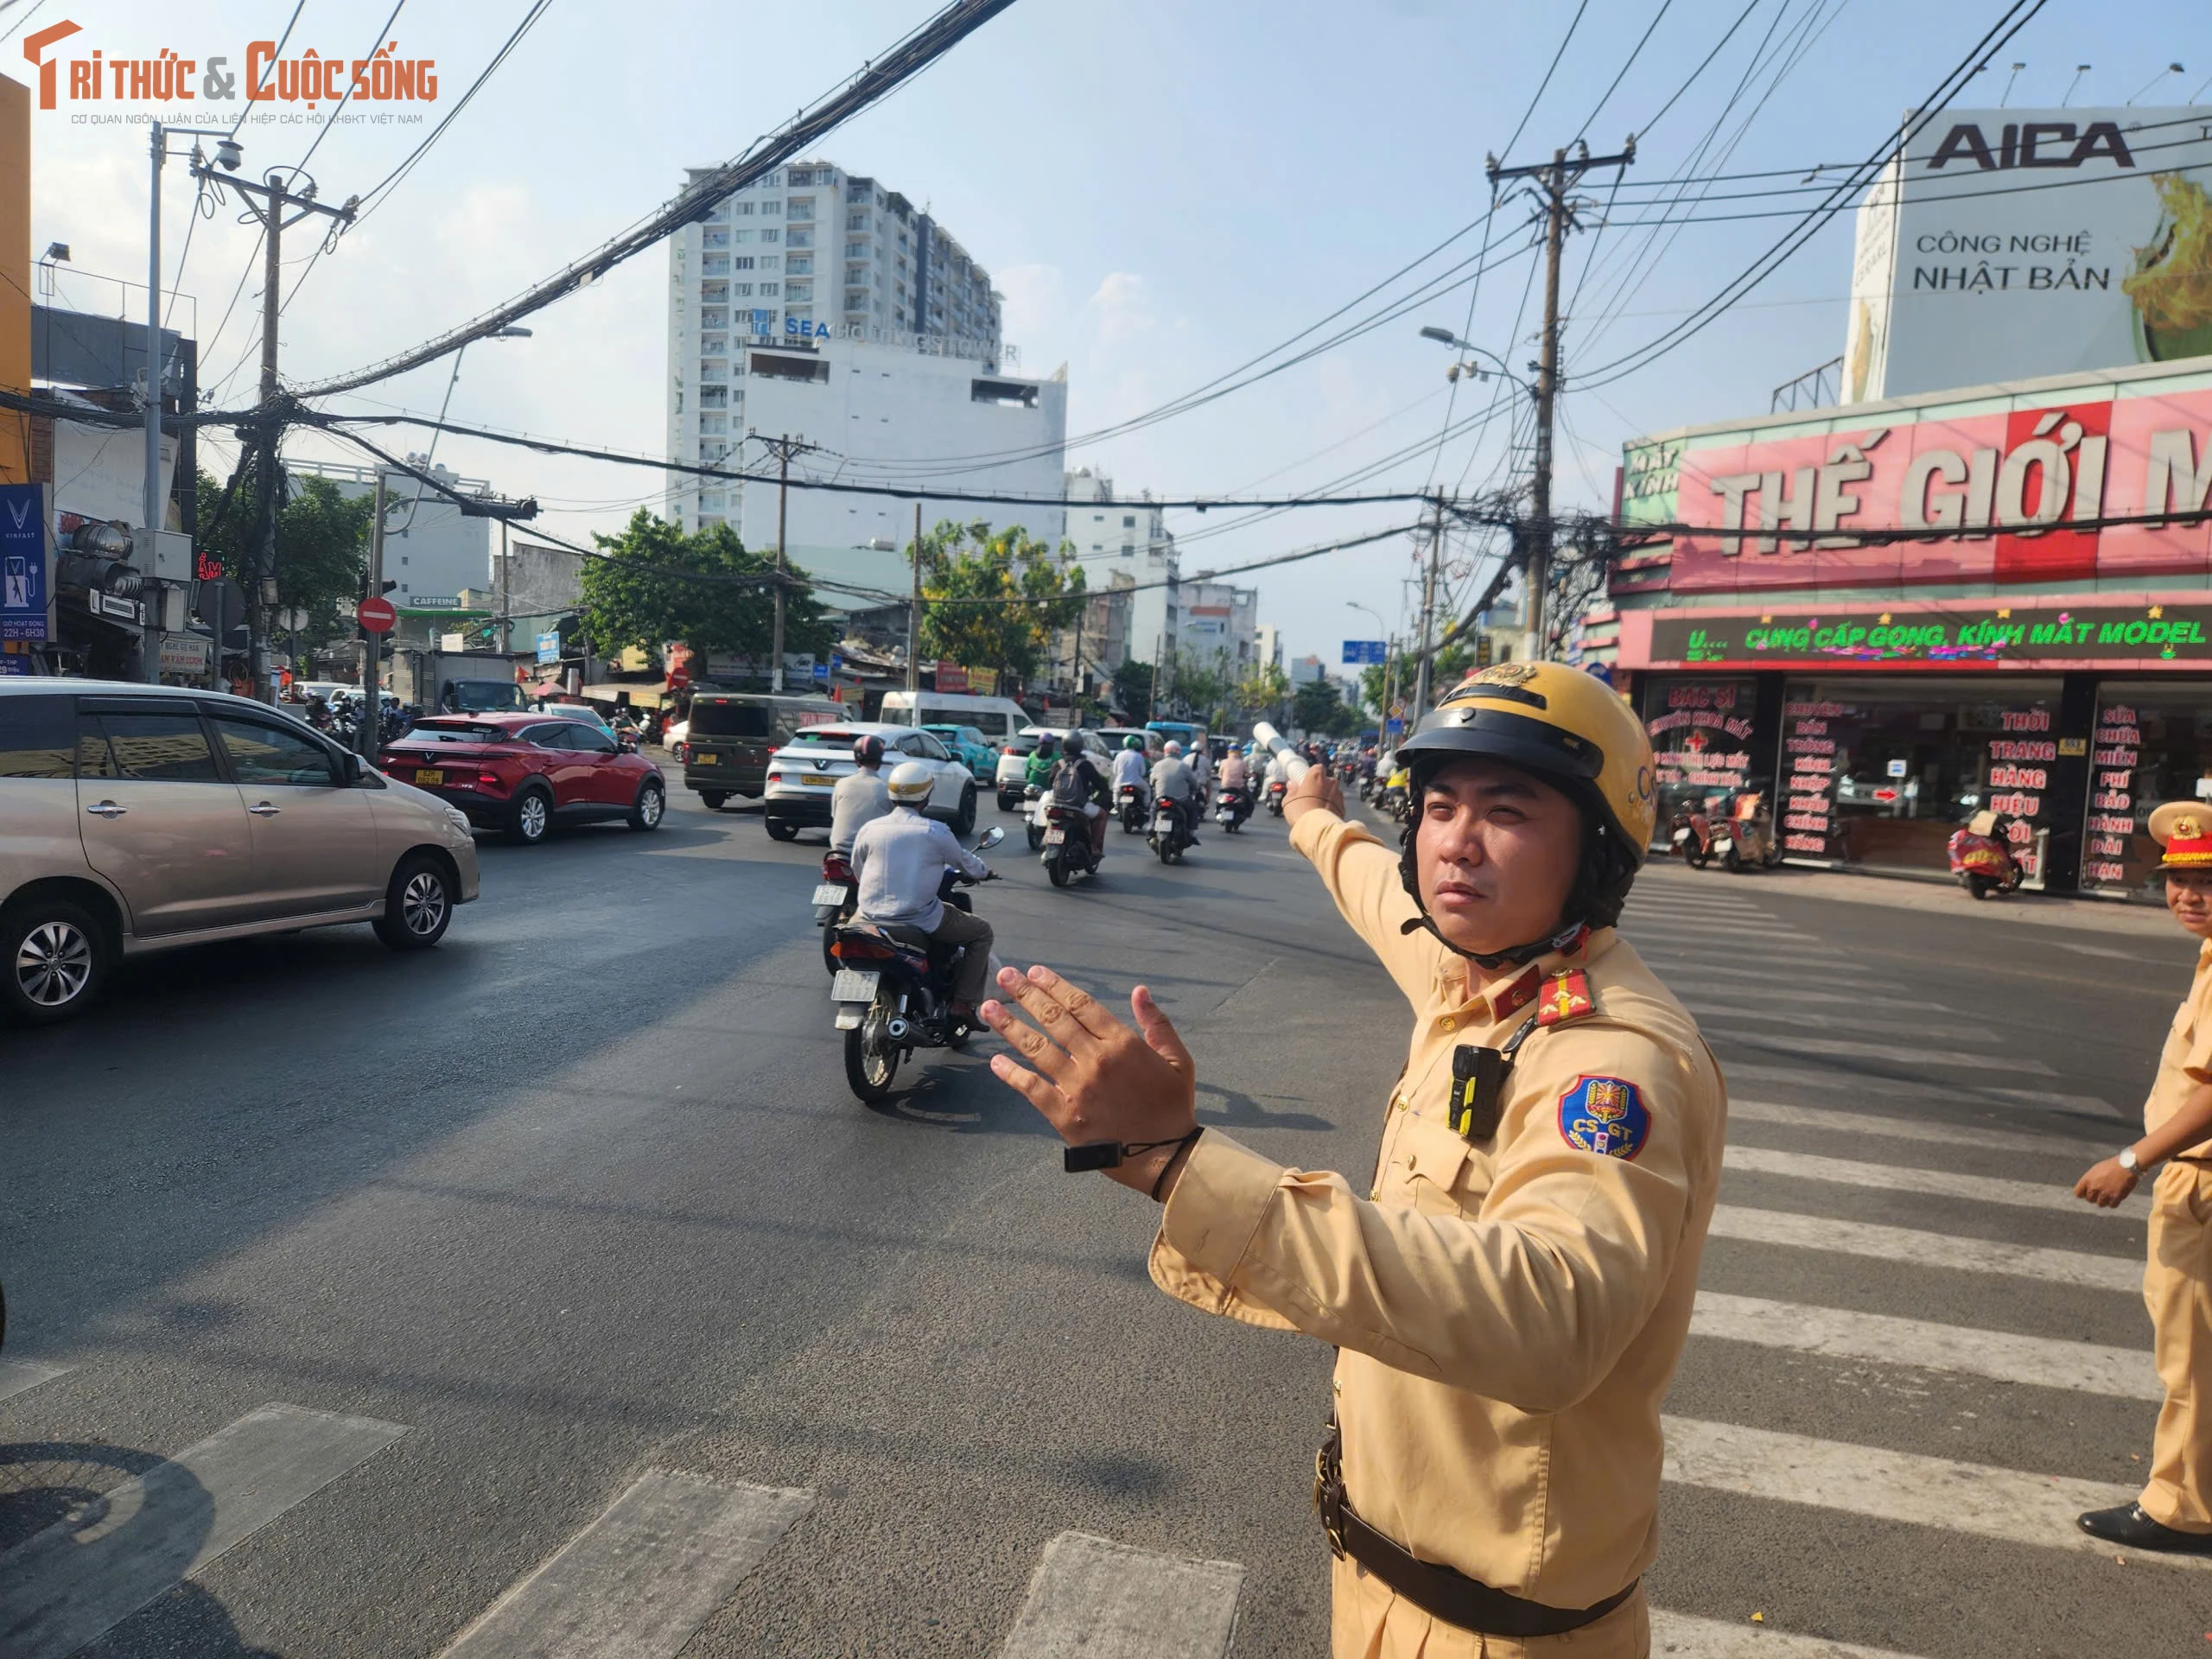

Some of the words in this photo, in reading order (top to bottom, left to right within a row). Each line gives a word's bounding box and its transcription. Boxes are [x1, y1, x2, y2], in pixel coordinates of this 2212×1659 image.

[1926, 122, 2135, 168] AICA
[1916, 230, 2000, 253] CÔNG
[2009, 229, 2092, 257] NGHỆ
[1912, 260, 2018, 296] NHẬT
[2029, 258, 2110, 291] BẢN
[785, 316, 830, 339] SEA
[1630, 442, 1678, 475] MẮT
[1624, 472, 1681, 499] KÍNH
[1711, 428, 1891, 558] THẾ
[1900, 411, 2108, 542] GIỚI
[413, 597, 458, 606] CAFFEINE
[3, 627, 19, 638] 22H
[25, 627, 44, 638] 6H30
[1815, 620, 1866, 647] CẤP
[1957, 619, 2025, 645] KÍNH
[2098, 620, 2206, 646] MODEL
[1668, 683, 1709, 709] BÁC
[1692, 709, 1725, 729] KHOA
[2000, 709, 2050, 732] THỜI
[2101, 704, 2137, 726] SỬA
[2094, 725, 2141, 746] CHỮA
[1989, 740, 2056, 761] TRANG
[2094, 745, 2139, 767] MIỄN
[1989, 763, 2047, 790] HÀNG
[2100, 768, 2132, 789] PHÍ
[1989, 791, 2040, 818] HIỆU
[2094, 788, 2132, 811] BẢO
[2088, 814, 2134, 835] HÀNH
[2088, 862, 2124, 881] HẠN
[1573, 1118, 1599, 1134] CS
[1607, 1122, 1634, 1141] GT
